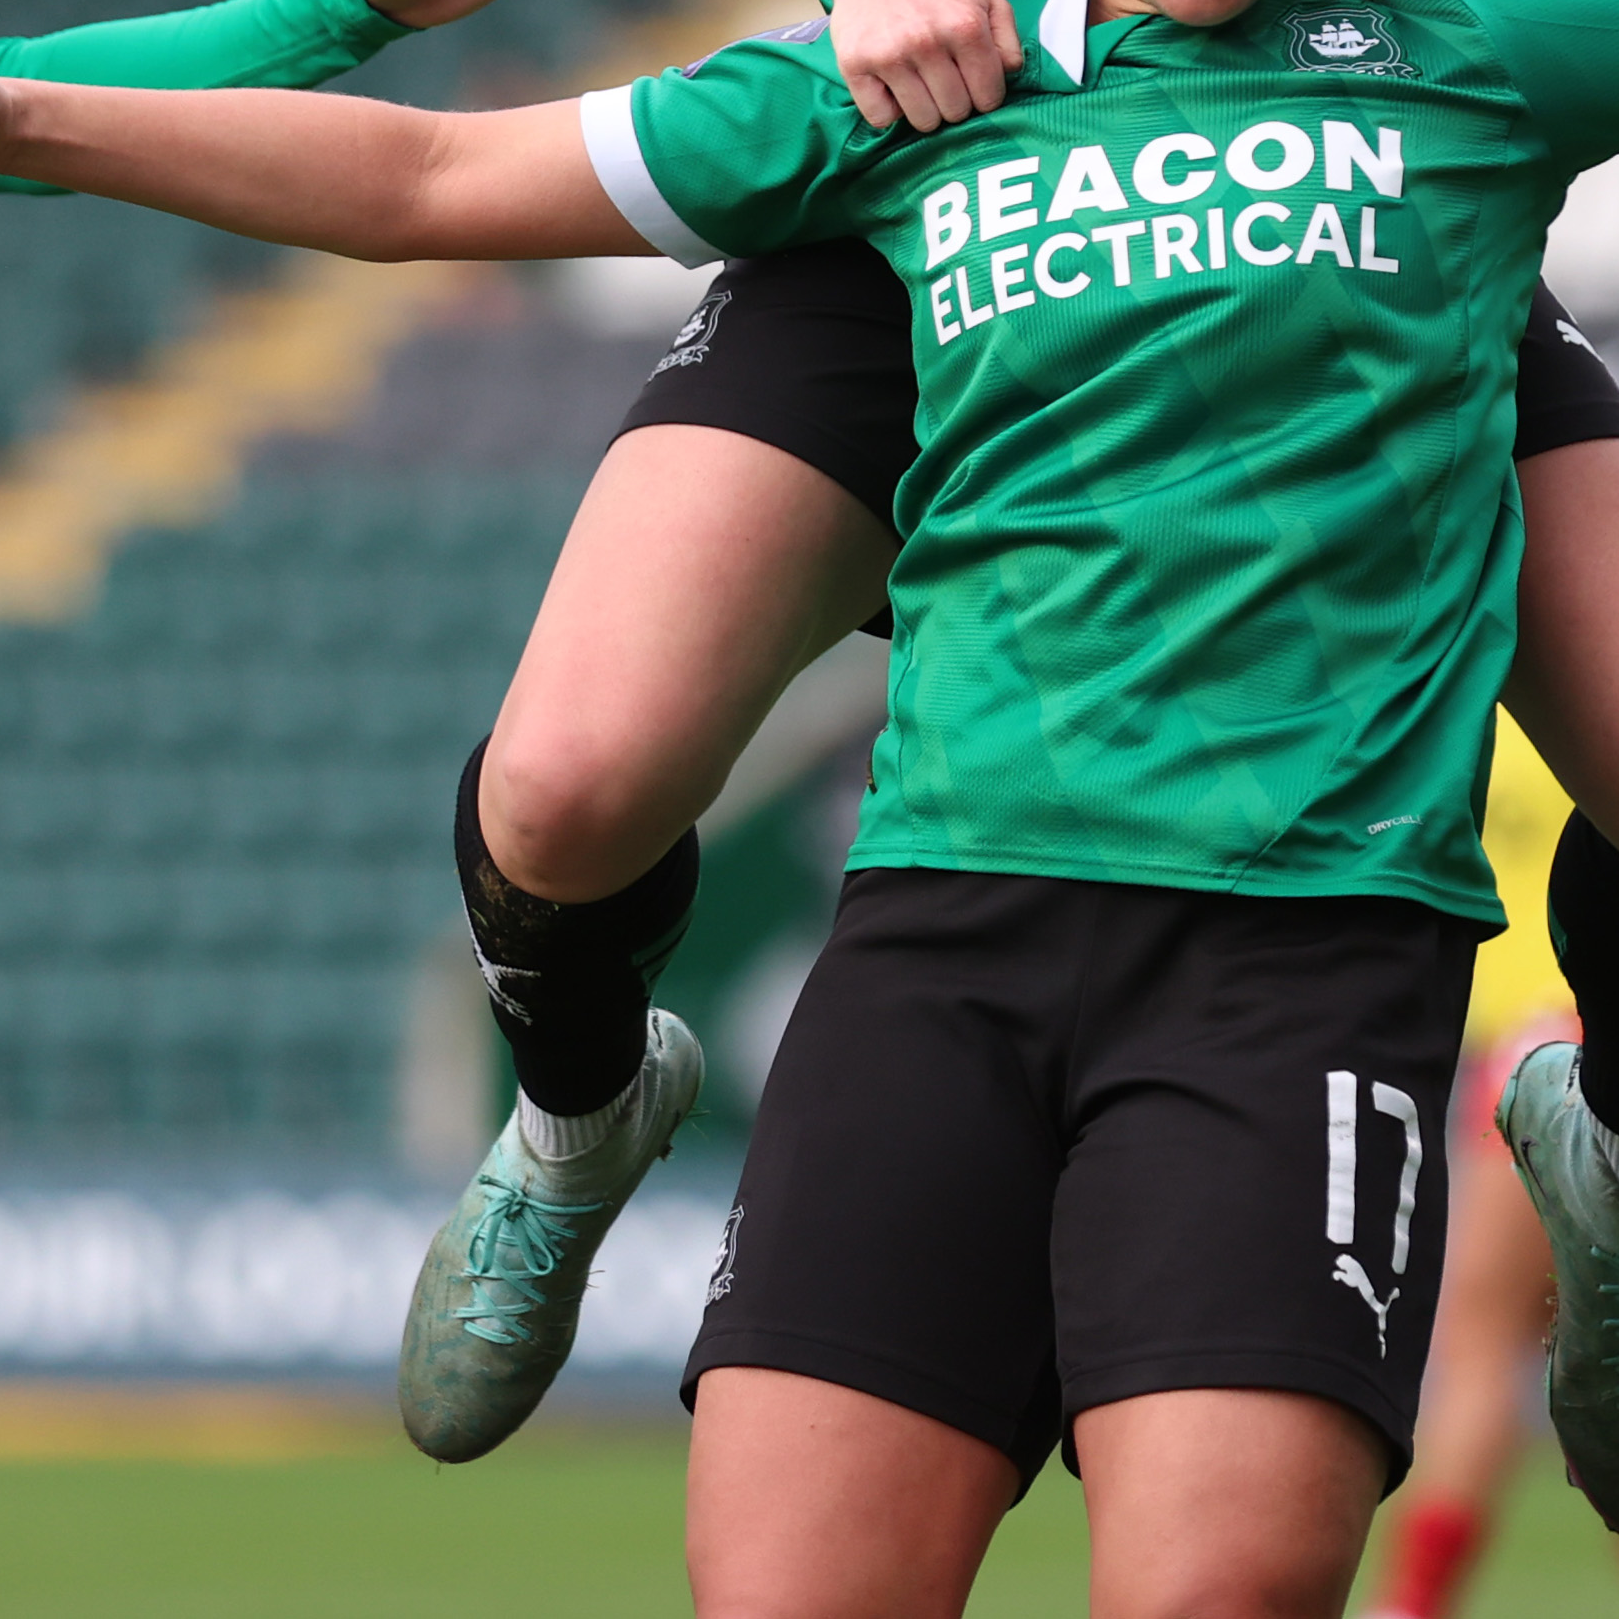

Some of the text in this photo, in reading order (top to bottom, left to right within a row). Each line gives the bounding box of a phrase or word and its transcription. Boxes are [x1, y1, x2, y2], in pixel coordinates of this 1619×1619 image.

[922, 120, 1404, 271] BEACON
[930, 201, 1400, 346] ELECTRICAL
[1367, 815, 1424, 835] DRYCELL
[1326, 1070, 1422, 1274] 17
